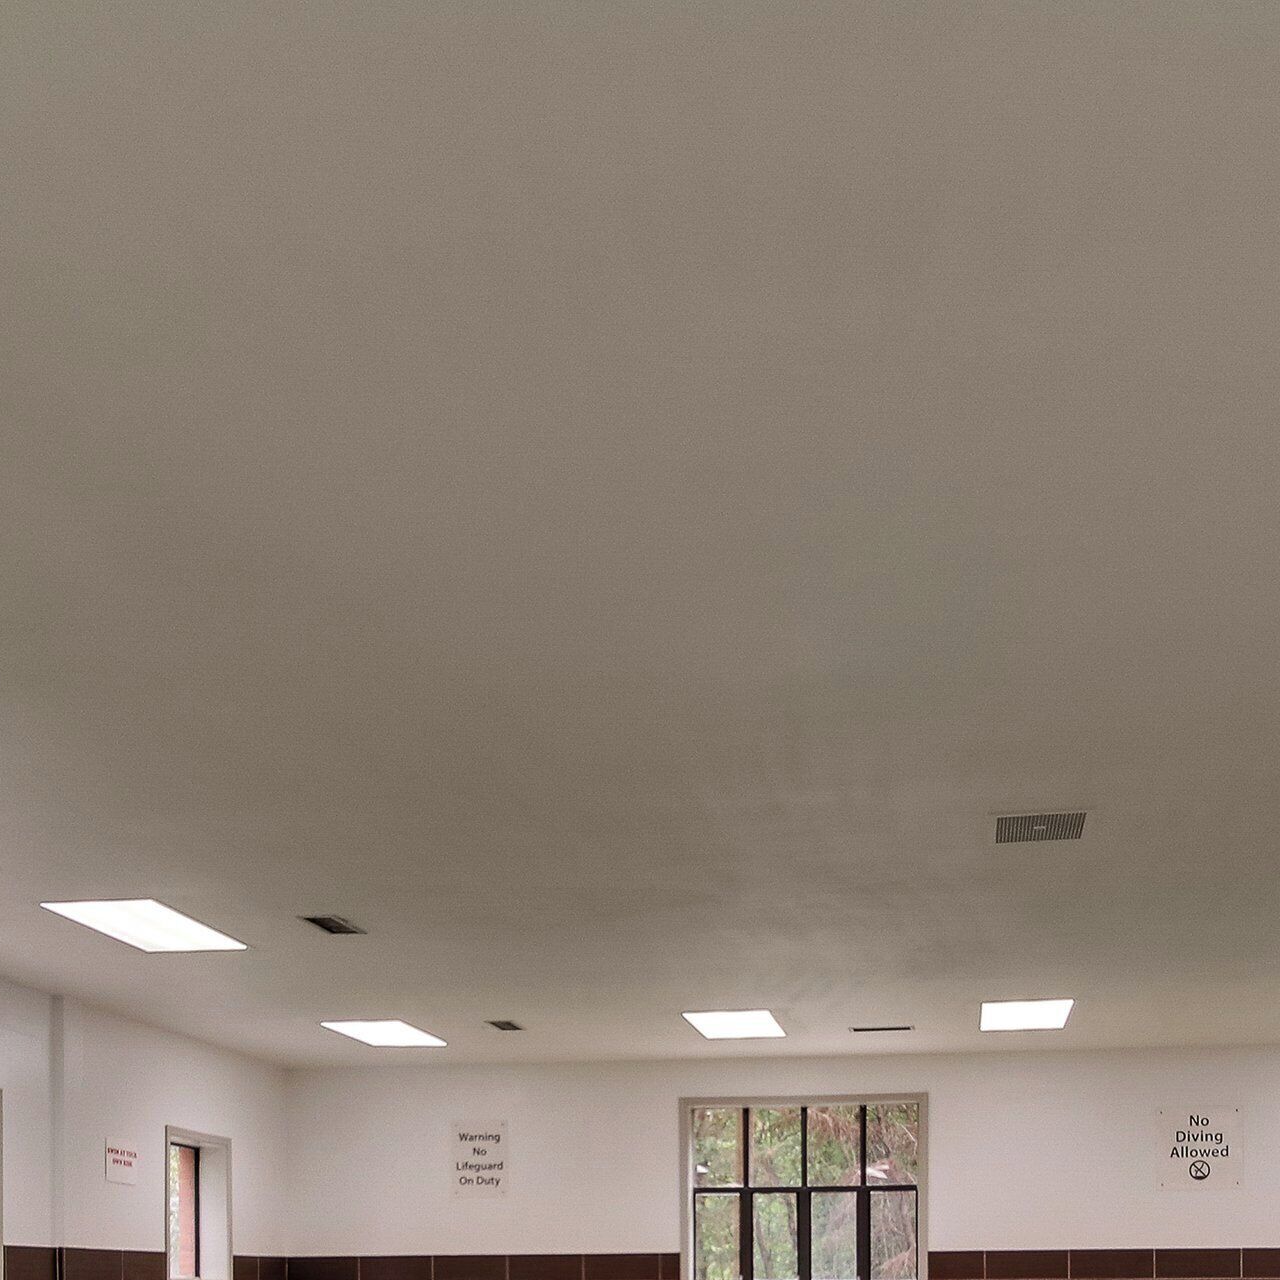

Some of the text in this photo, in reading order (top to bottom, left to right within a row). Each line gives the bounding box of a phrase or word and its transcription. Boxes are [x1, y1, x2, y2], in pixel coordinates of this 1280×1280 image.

[1189, 1114, 1209, 1126] No
[458, 1132, 501, 1144] Warning
[1176, 1130, 1223, 1145] Diving
[472, 1147, 487, 1156] No
[1170, 1145, 1229, 1158] Allowed
[456, 1161, 504, 1173] Lifeguard
[459, 1176, 501, 1188] On Duty
